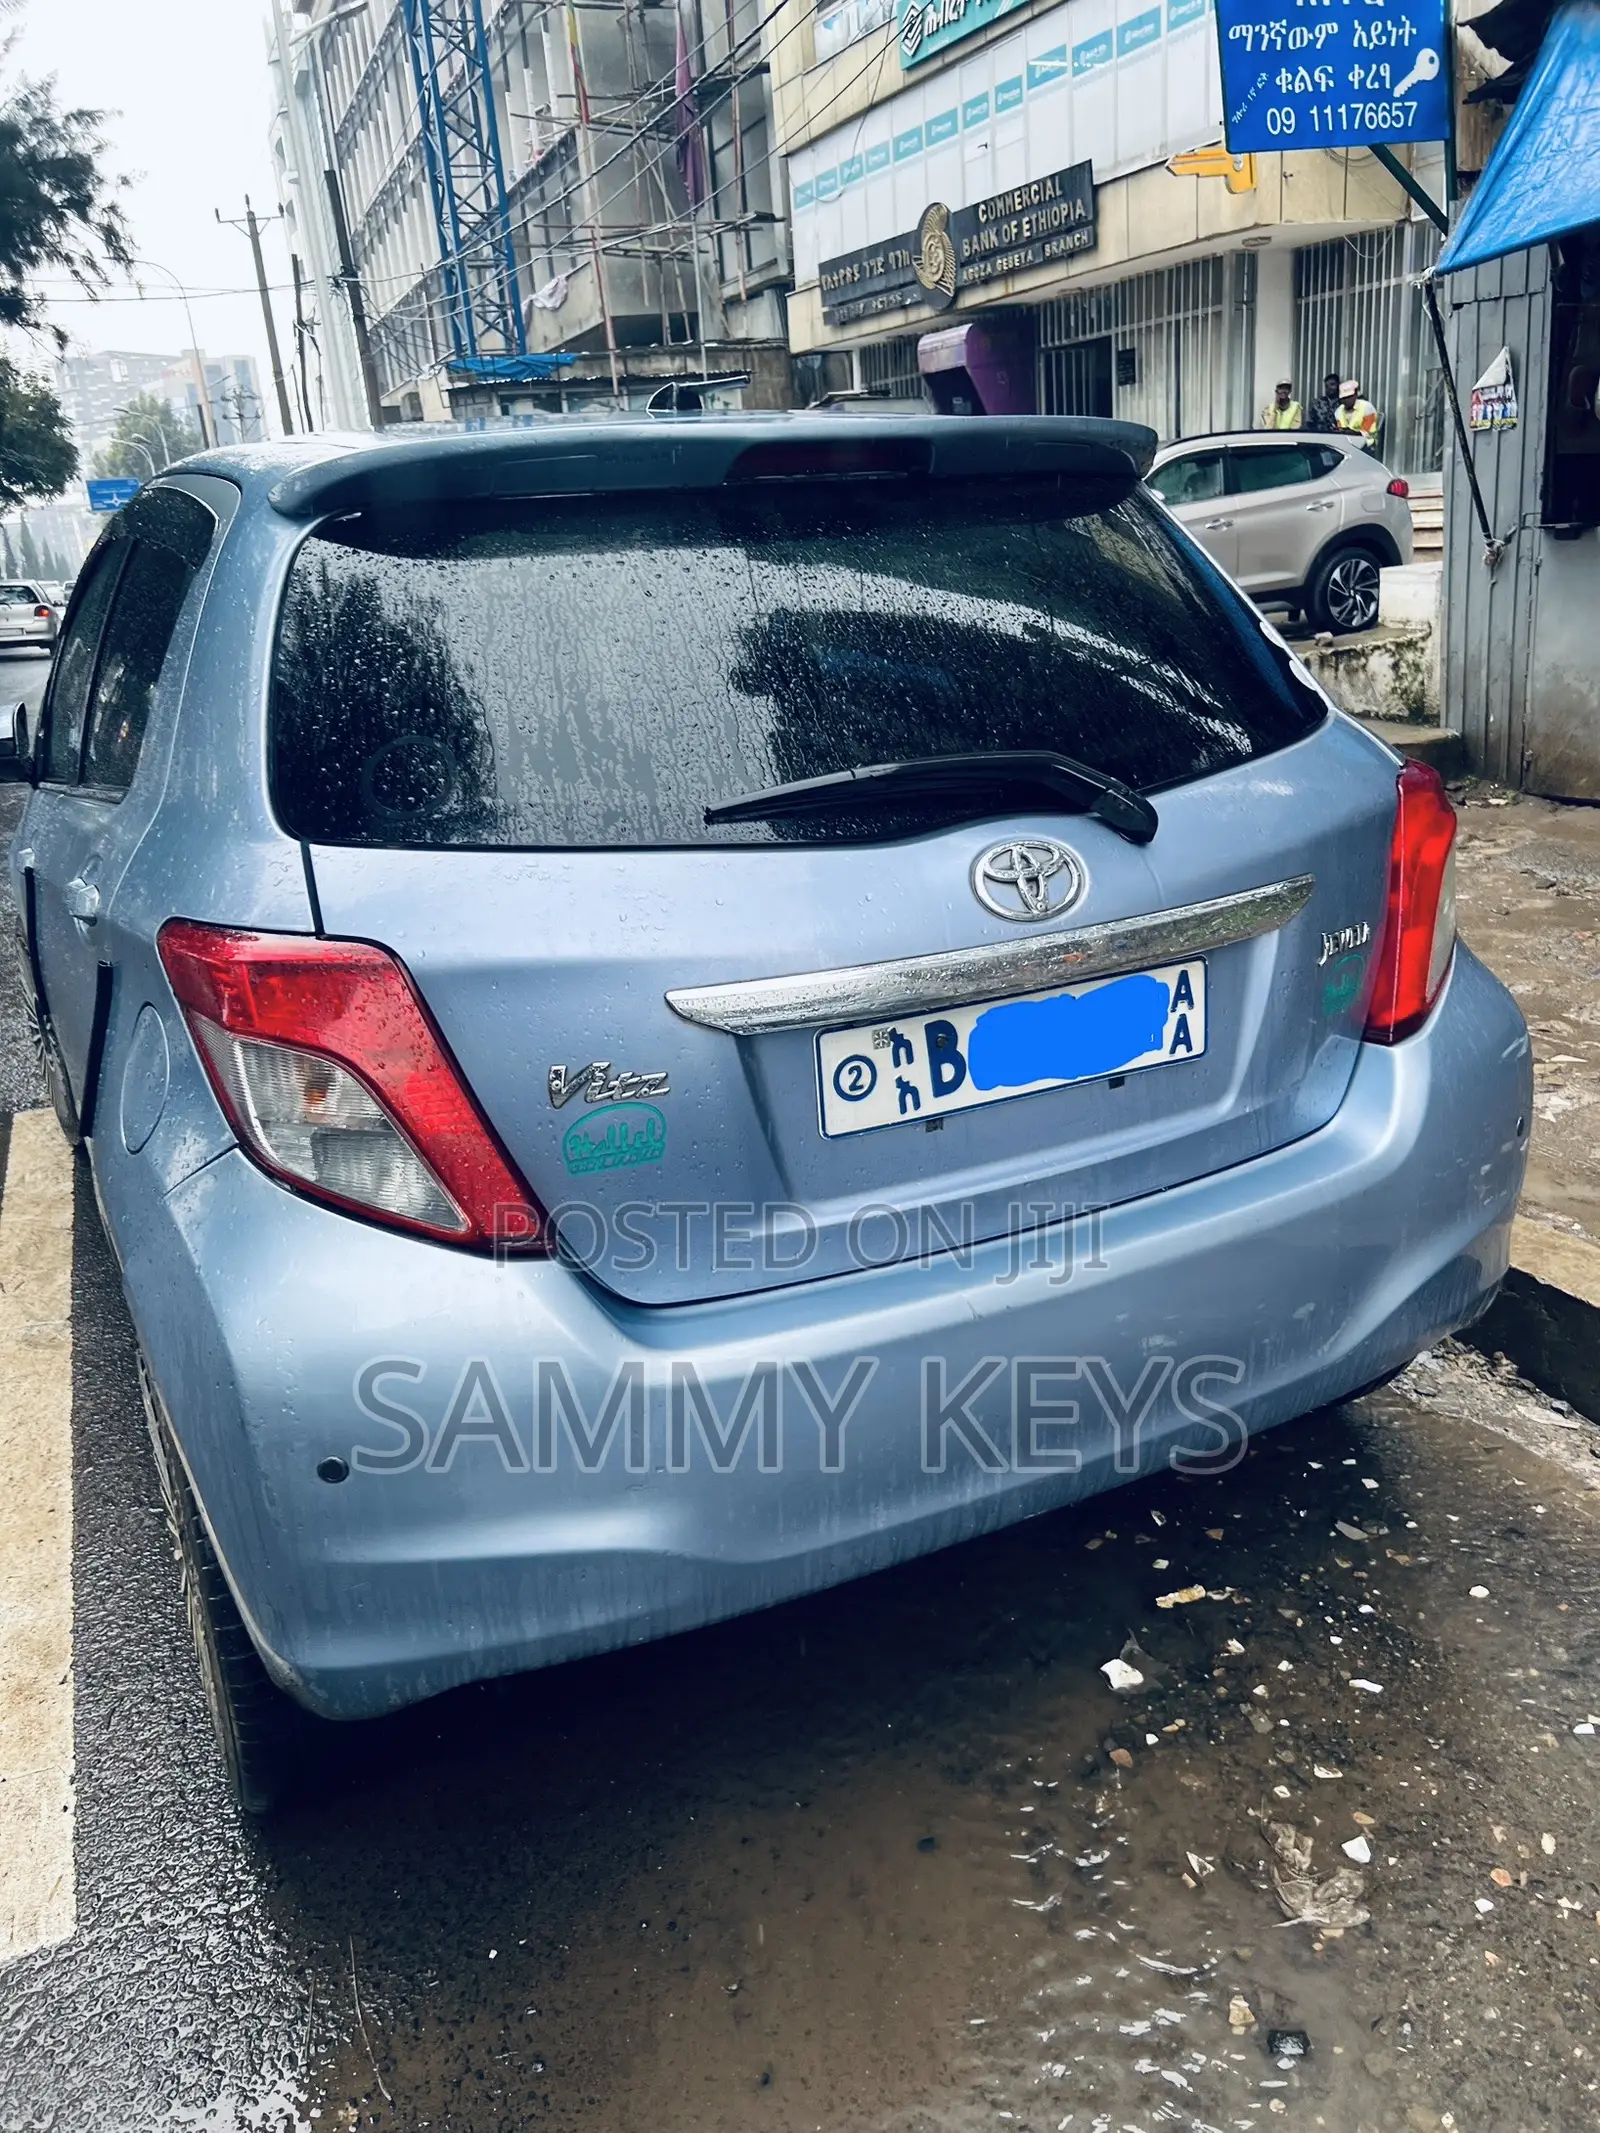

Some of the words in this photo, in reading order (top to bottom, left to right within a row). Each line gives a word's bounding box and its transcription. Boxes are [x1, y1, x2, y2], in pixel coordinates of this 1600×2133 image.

[1228, 19, 1339, 51] ማንኛውም
[1353, 15, 1417, 50] አይነት
[1275, 65, 1335, 94] ቁልፍ
[1266, 106, 1296, 135] 09
[1310, 101, 1418, 132] 11176657
[978, 175, 1062, 224] COMMERCIAL
[962, 227, 999, 257] BANK
[1002, 220, 1018, 243] OF
[1022, 198, 1086, 238] ETHIOPIA
[1044, 230, 1088, 257] BRANCH
